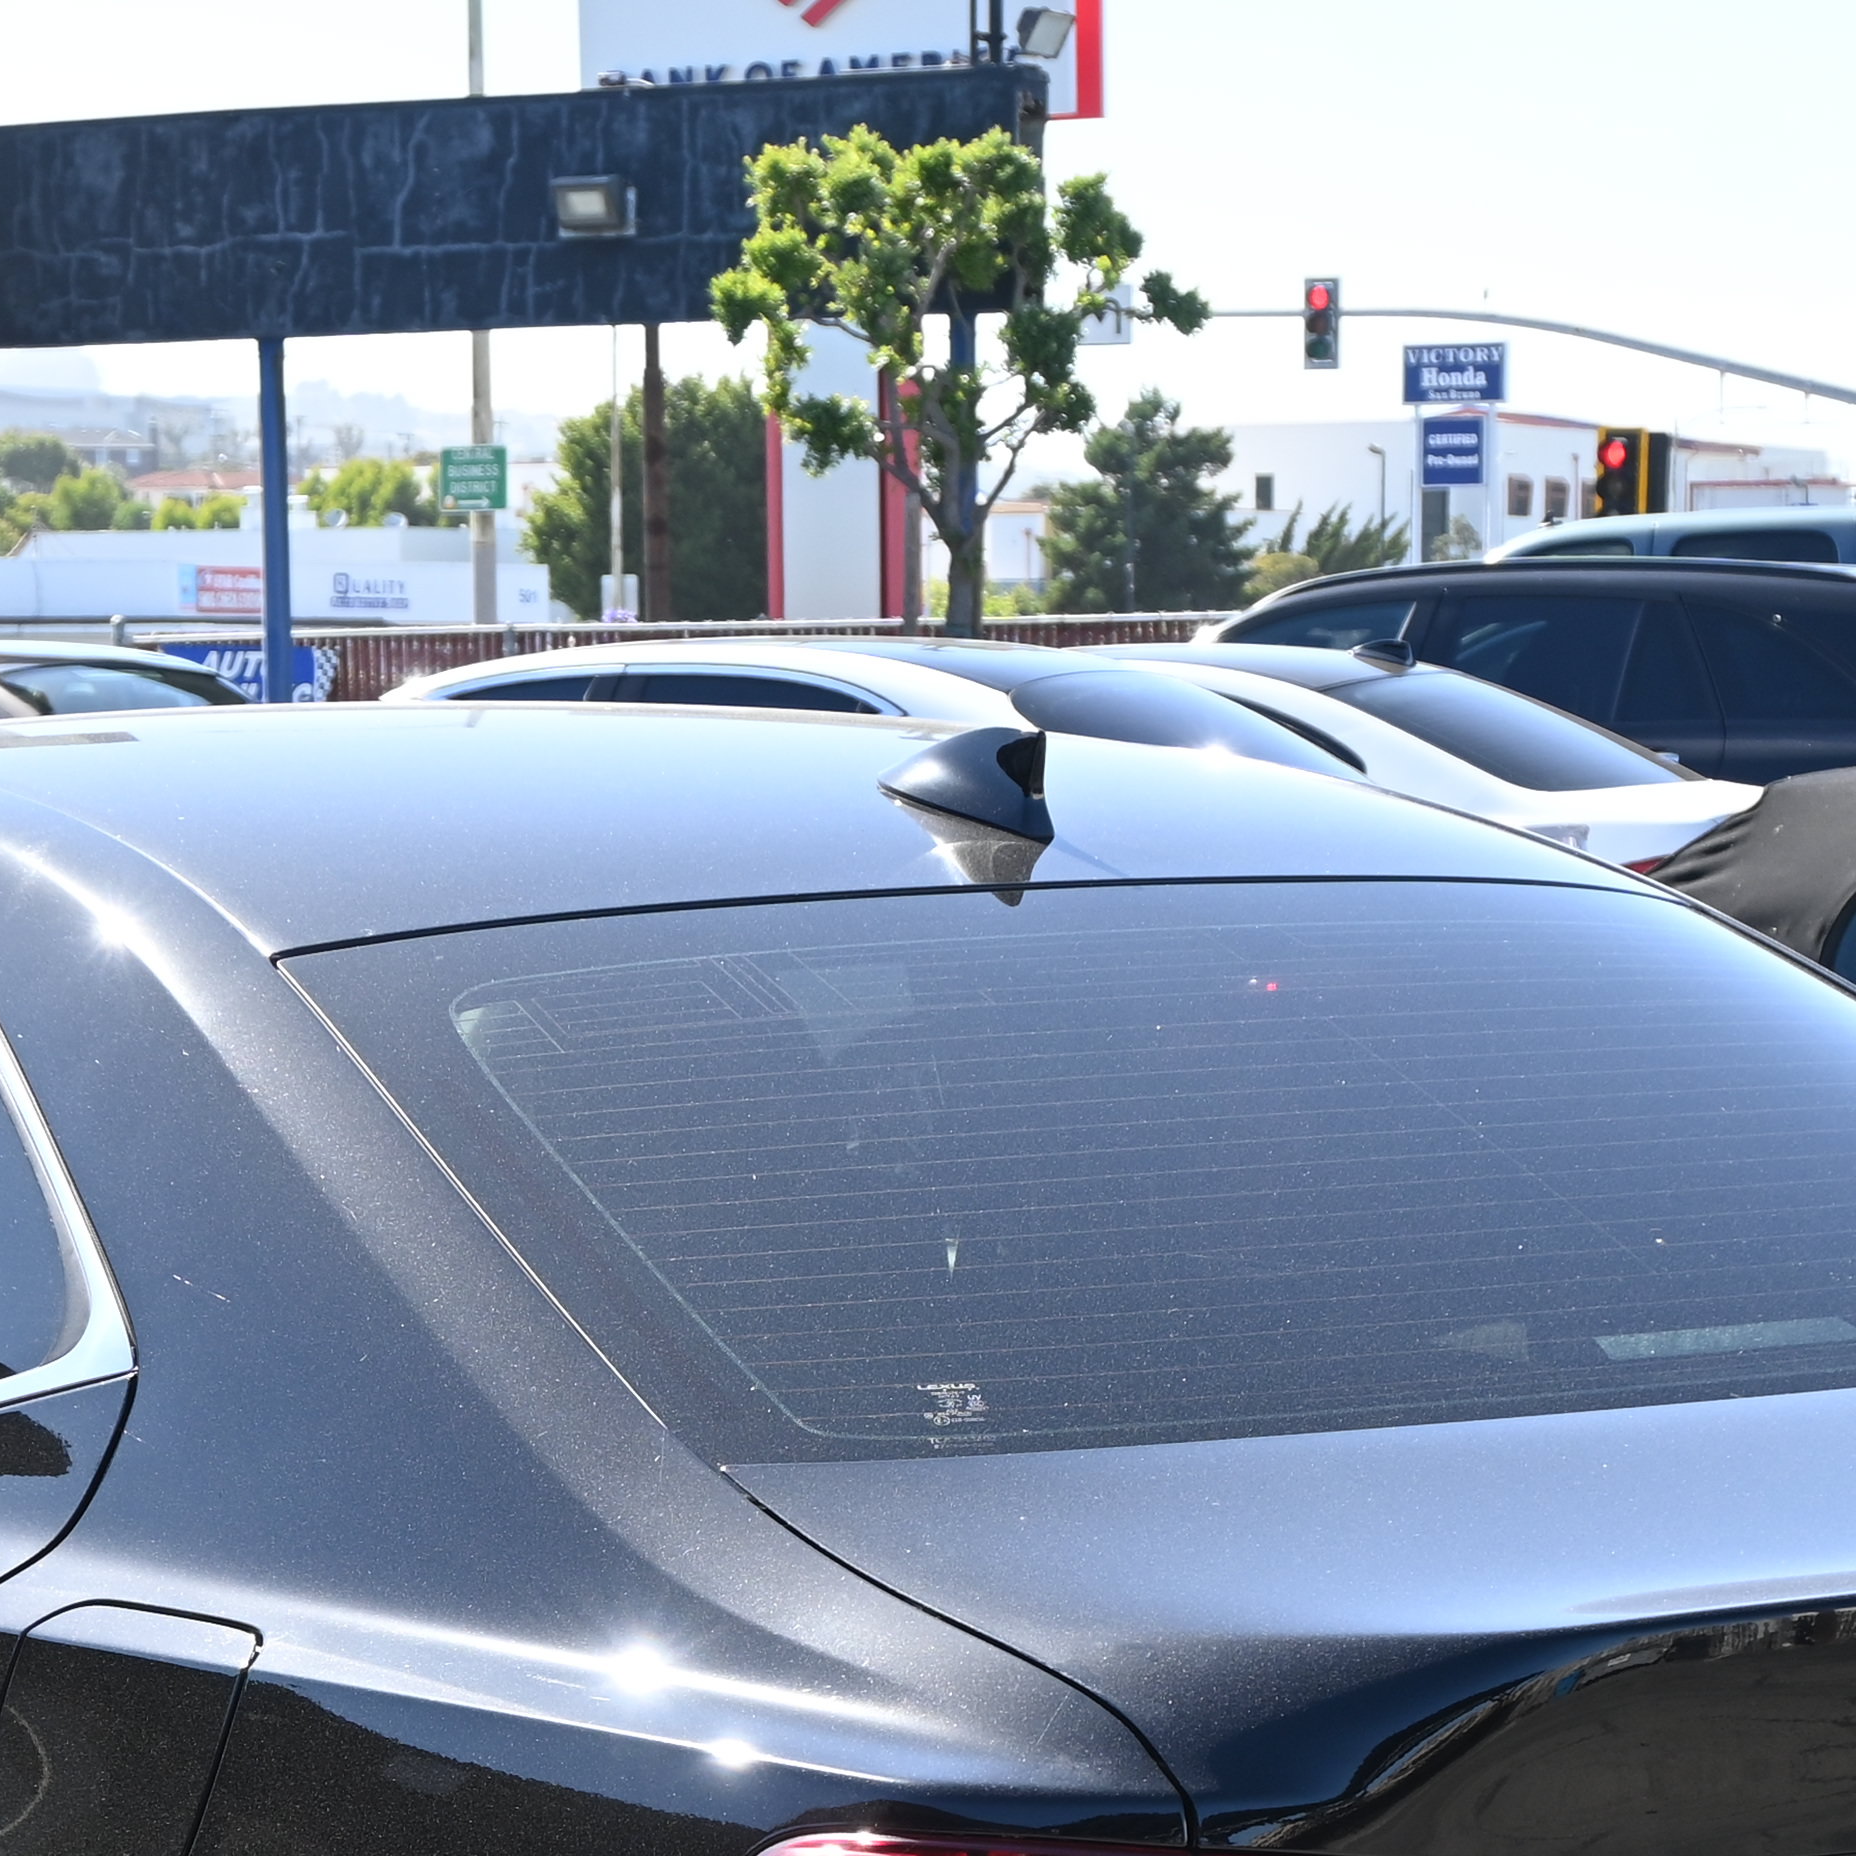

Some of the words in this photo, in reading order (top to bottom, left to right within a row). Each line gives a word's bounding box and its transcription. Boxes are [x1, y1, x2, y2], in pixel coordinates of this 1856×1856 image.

[640, 63, 728, 85] ANK
[1406, 346, 1503, 363] VICTORY
[1420, 365, 1487, 387] Honda
[1428, 390, 1448, 399] San
[1450, 389, 1481, 400] Bruno
[1428, 433, 1478, 445] CERTIFIED
[451, 447, 495, 460] CENTRAL
[1426, 453, 1479, 466] Pre-Owned
[447, 463, 499, 477] BUSINESS
[449, 480, 497, 493] DISTRICT
[202, 650, 265, 680] AUT
